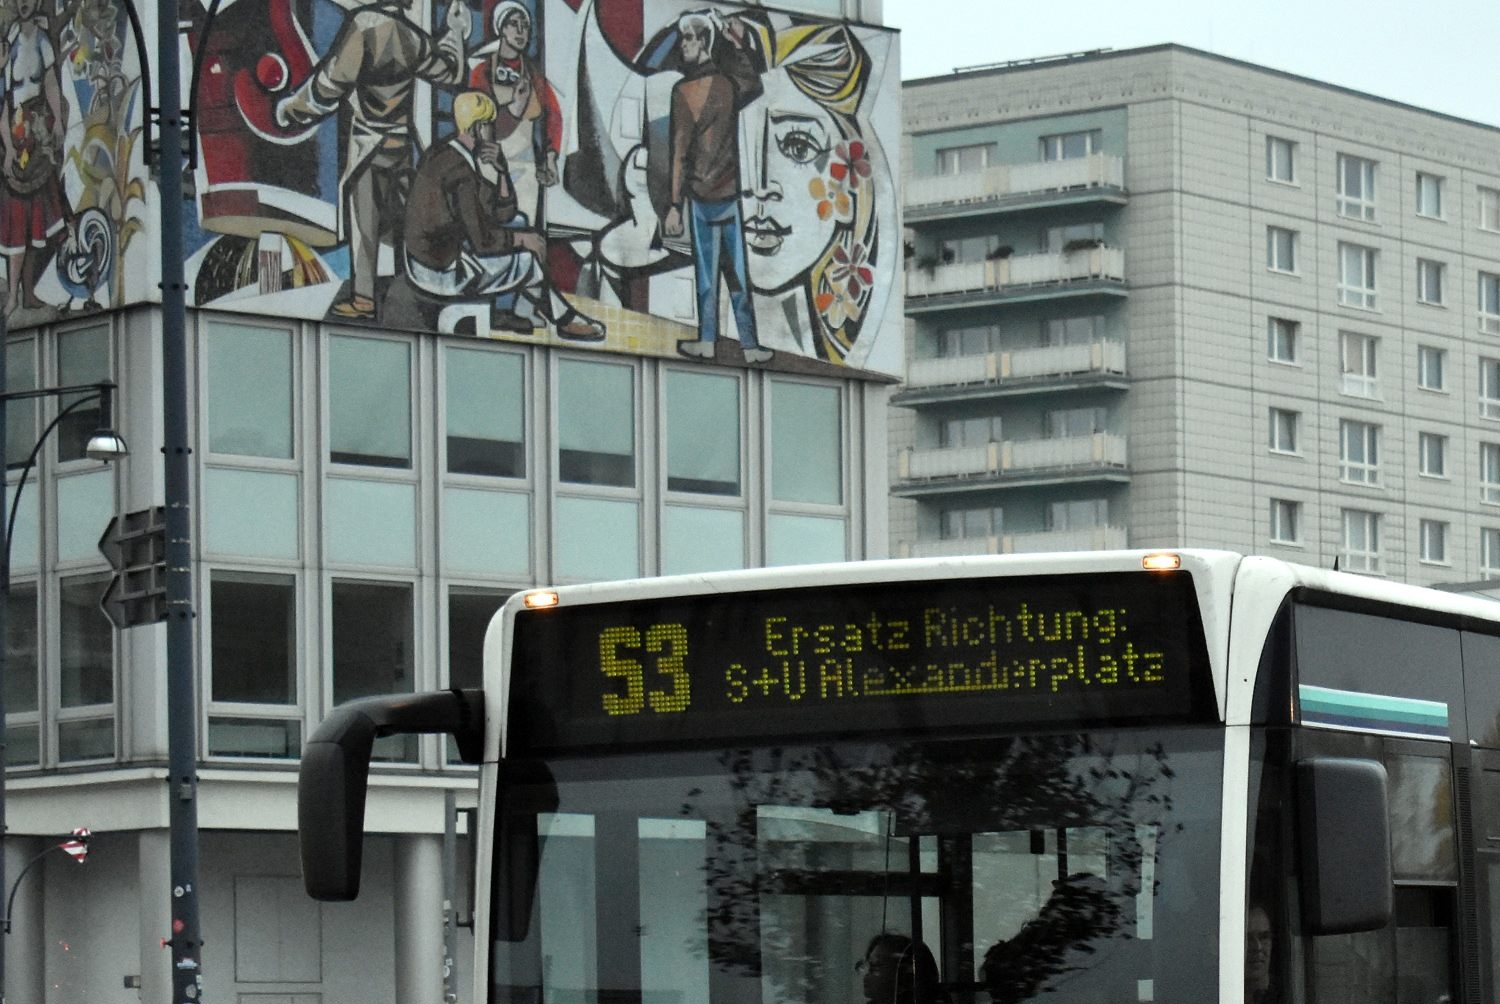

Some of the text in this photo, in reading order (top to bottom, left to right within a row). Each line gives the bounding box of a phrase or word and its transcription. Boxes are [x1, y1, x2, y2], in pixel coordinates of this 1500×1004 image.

[765, 602, 1128, 657] Ersatz Richtung:
[598, 622, 692, 717] S3
[725, 659, 806, 704] S+U
